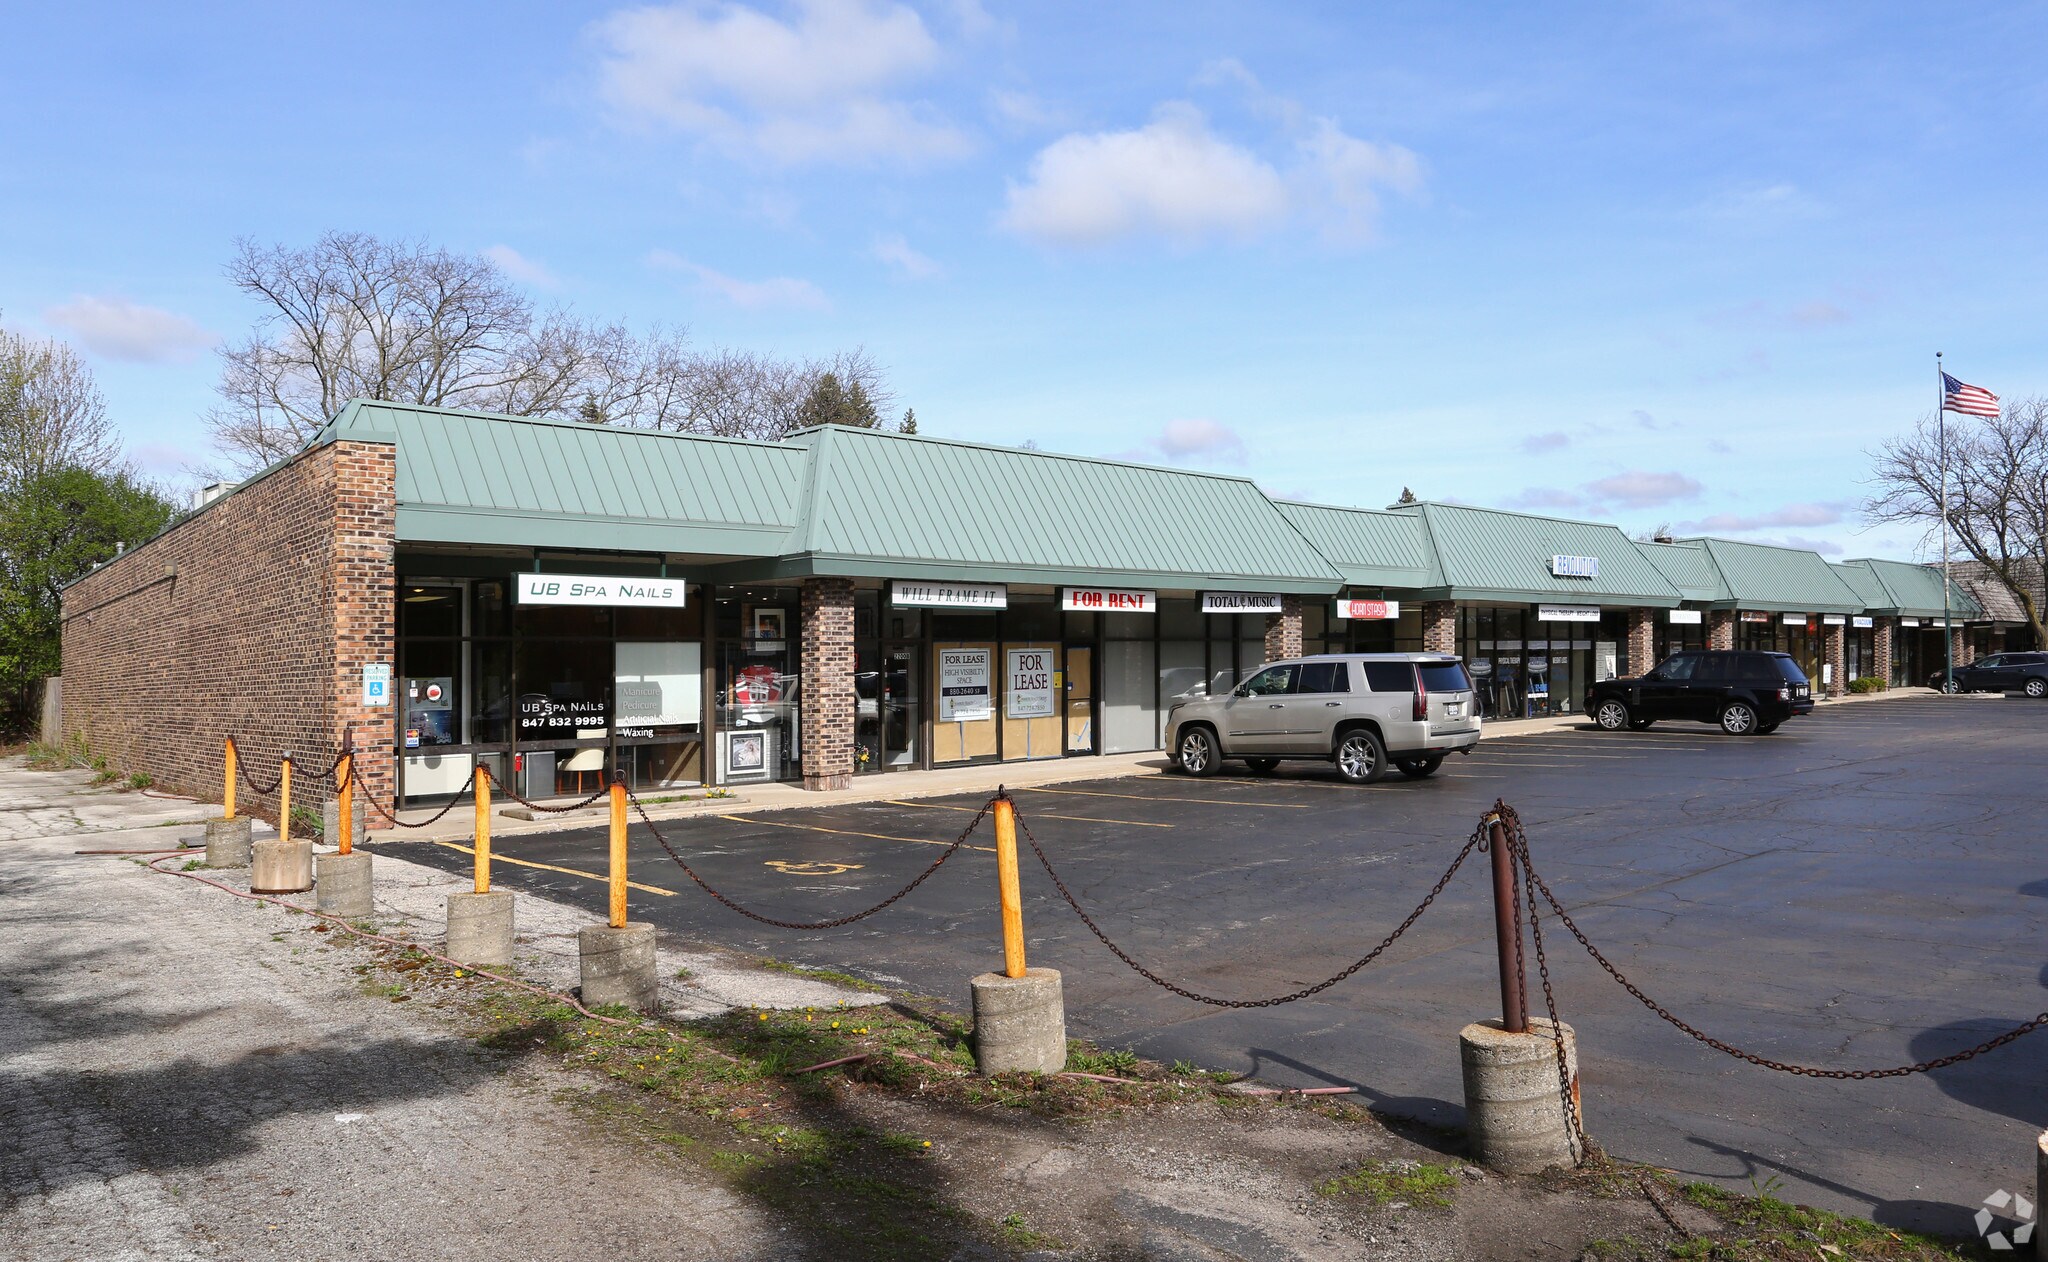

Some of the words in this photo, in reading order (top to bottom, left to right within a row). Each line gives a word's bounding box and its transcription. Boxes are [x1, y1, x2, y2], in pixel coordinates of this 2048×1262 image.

[1557, 556, 1598, 576] REVOLUTION
[530, 582, 560, 596] UB
[902, 587, 932, 601] WILL
[938, 588, 979, 603] FRAME
[983, 590, 996, 603] IT
[1072, 591, 1103, 607] FOR
[1109, 593, 1146, 609] RENT
[1208, 596, 1240, 608] TOTAL
[1246, 596, 1276, 608] MUSIC
[945, 655, 961, 664] FOR
[963, 655, 985, 664] LEASE
[1019, 654, 1043, 671] FOR
[956, 676, 972, 685] SPACE
[1014, 673, 1048, 691] LEASE
[622, 687, 661, 697] Manicure
[522, 703, 540, 713] UB
[622, 700, 657, 710] Pedicure
[522, 718, 544, 727] 847
[549, 717, 572, 727] 832
[575, 716, 604, 726] 9995
[622, 714, 657, 725] Artificial
[622, 727, 654, 739] Waxing
